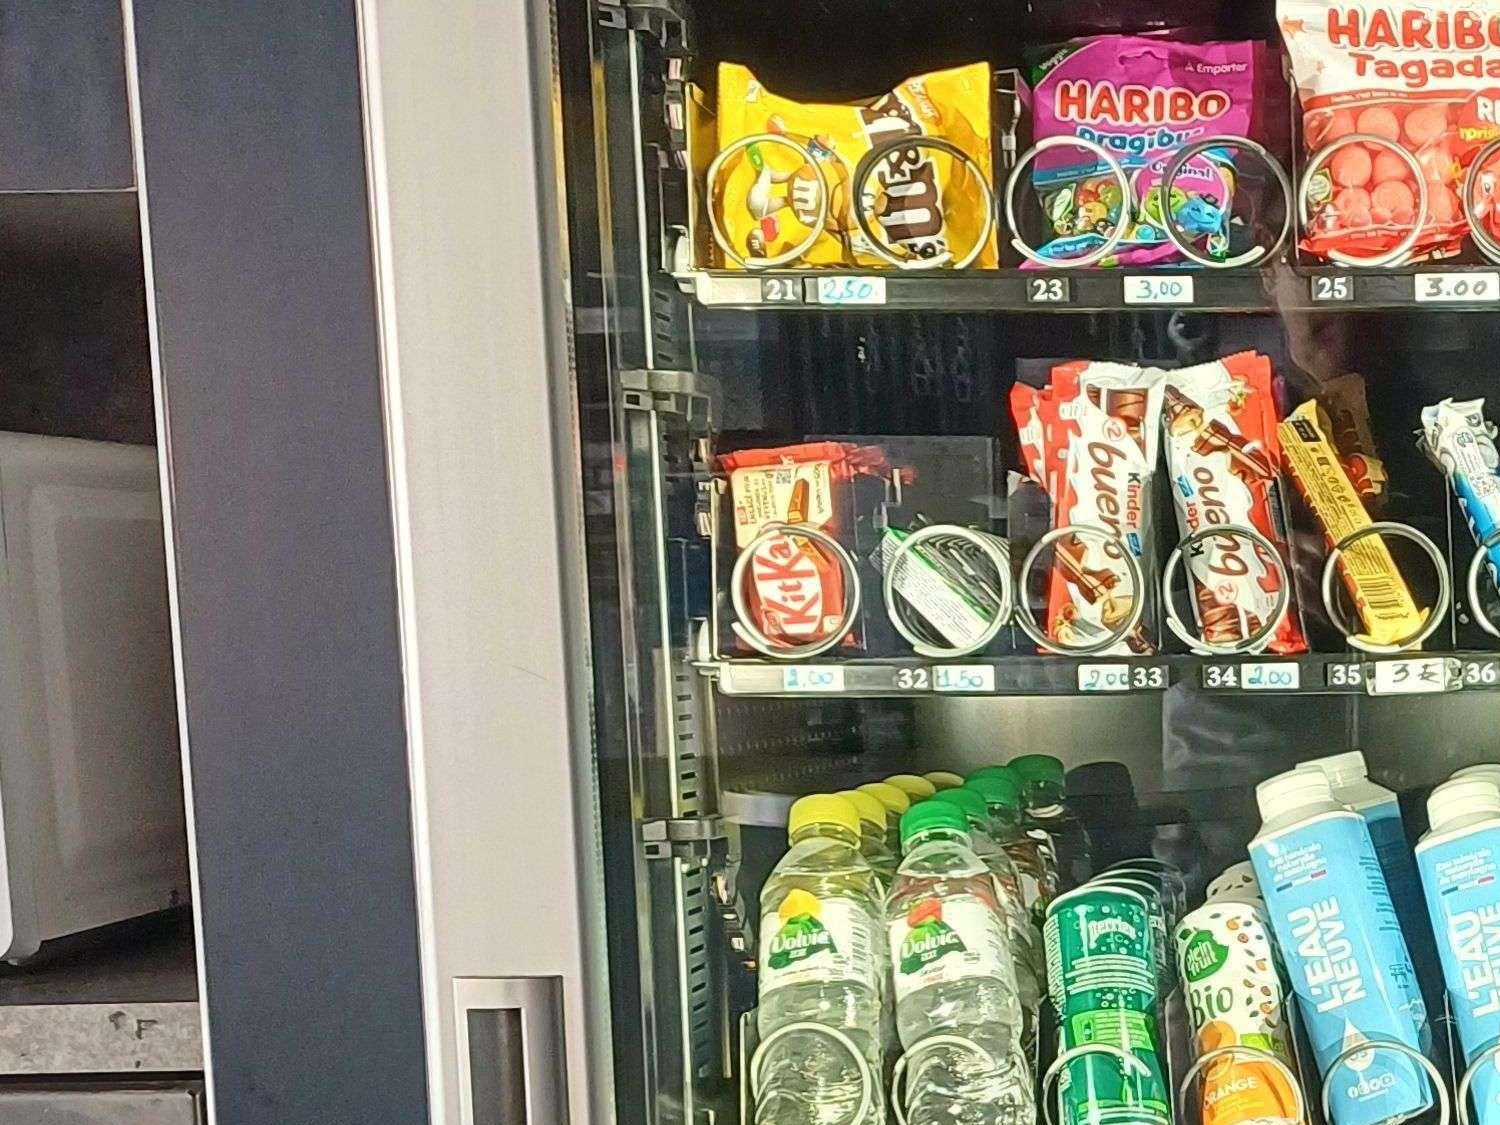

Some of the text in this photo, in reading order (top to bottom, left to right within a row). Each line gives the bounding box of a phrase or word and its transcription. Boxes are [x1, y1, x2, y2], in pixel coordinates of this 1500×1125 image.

[1057, 83, 1227, 123] HARIBO
[1152, 162, 1211, 178] Orginal
[766, 280, 797, 299] 21
[1032, 279, 1062, 299] 23
[1318, 277, 1347, 299] 25
[1087, 440, 1128, 560] bueno
[1186, 500, 1205, 558] Kder
[756, 540, 818, 627] KitKa
[898, 668, 928, 689] 32
[1134, 667, 1162, 687] 33
[1207, 666, 1237, 687] 34
[1332, 664, 1361, 685] 35
[1466, 663, 1495, 684] 36
[1287, 906, 1344, 1012] L'EAU
[1316, 895, 1367, 1003] NEUVE
[1447, 911, 1500, 1018] L'EAU
[1204, 1076, 1259, 1108] ORANGE
